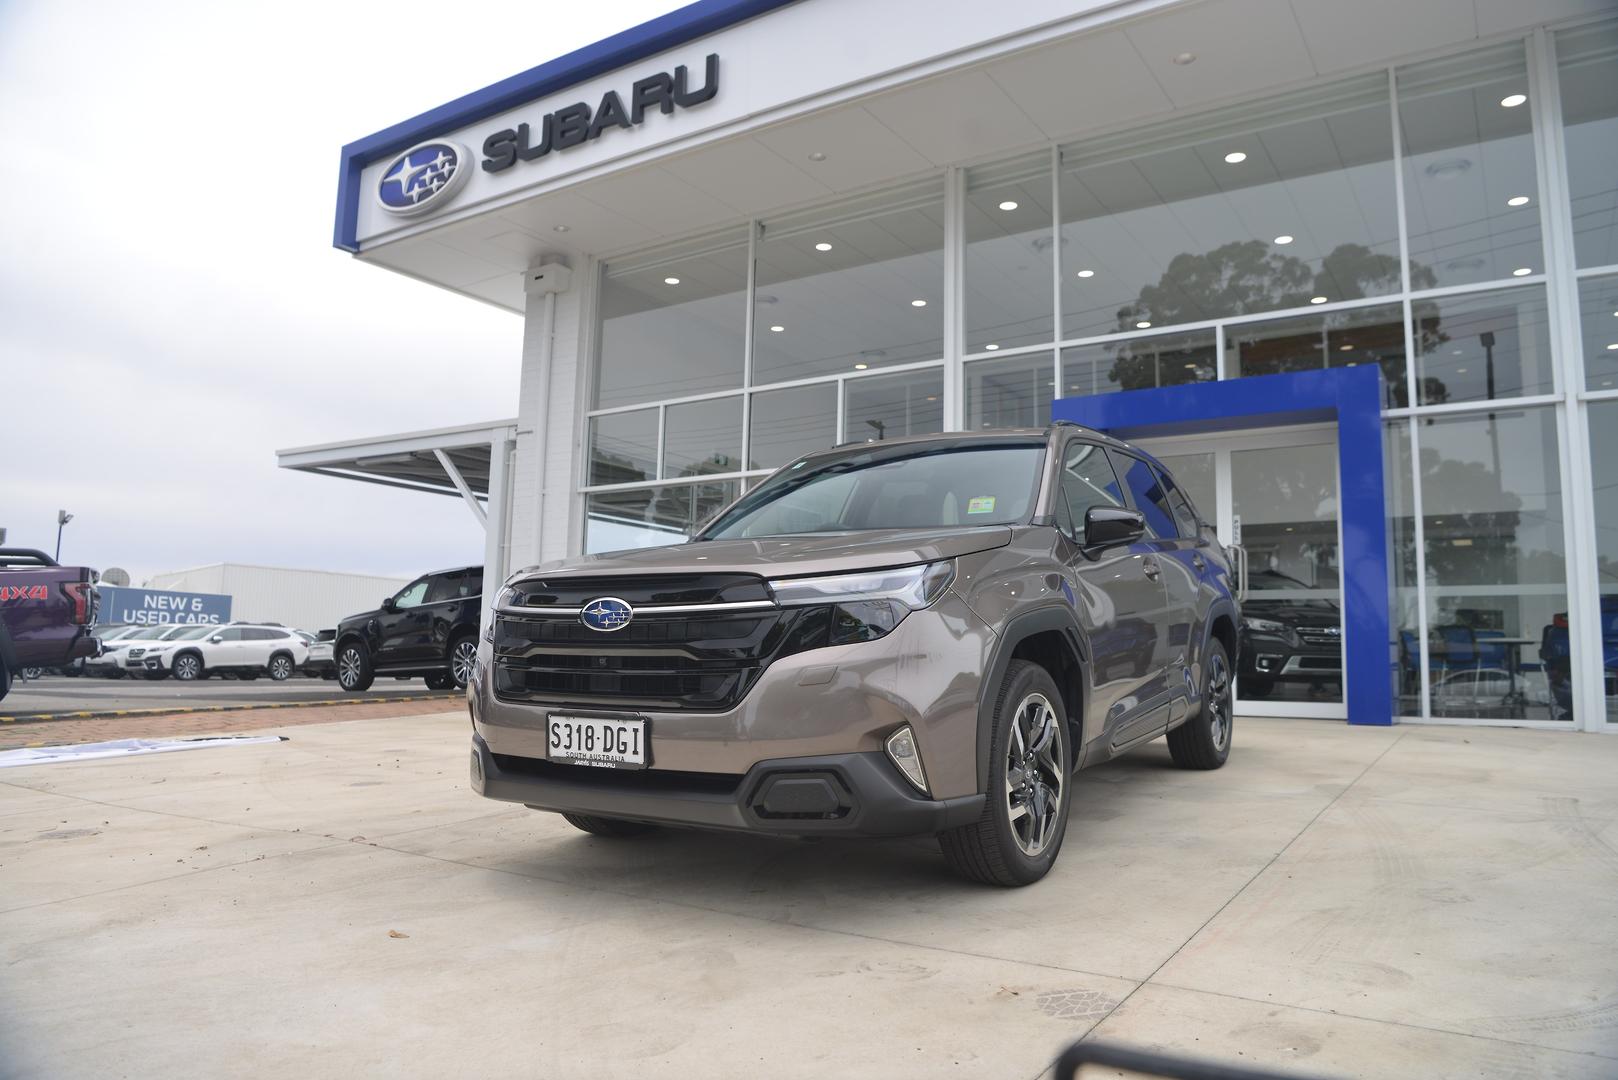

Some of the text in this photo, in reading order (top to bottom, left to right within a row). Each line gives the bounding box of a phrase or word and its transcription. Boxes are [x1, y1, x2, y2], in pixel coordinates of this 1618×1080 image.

[482, 53, 720, 173] SUBARU
[143, 594, 203, 612] NEW &
[123, 609, 219, 624] USED CARS
[566, 751, 625, 763] SOUTH AUSTRALIA
